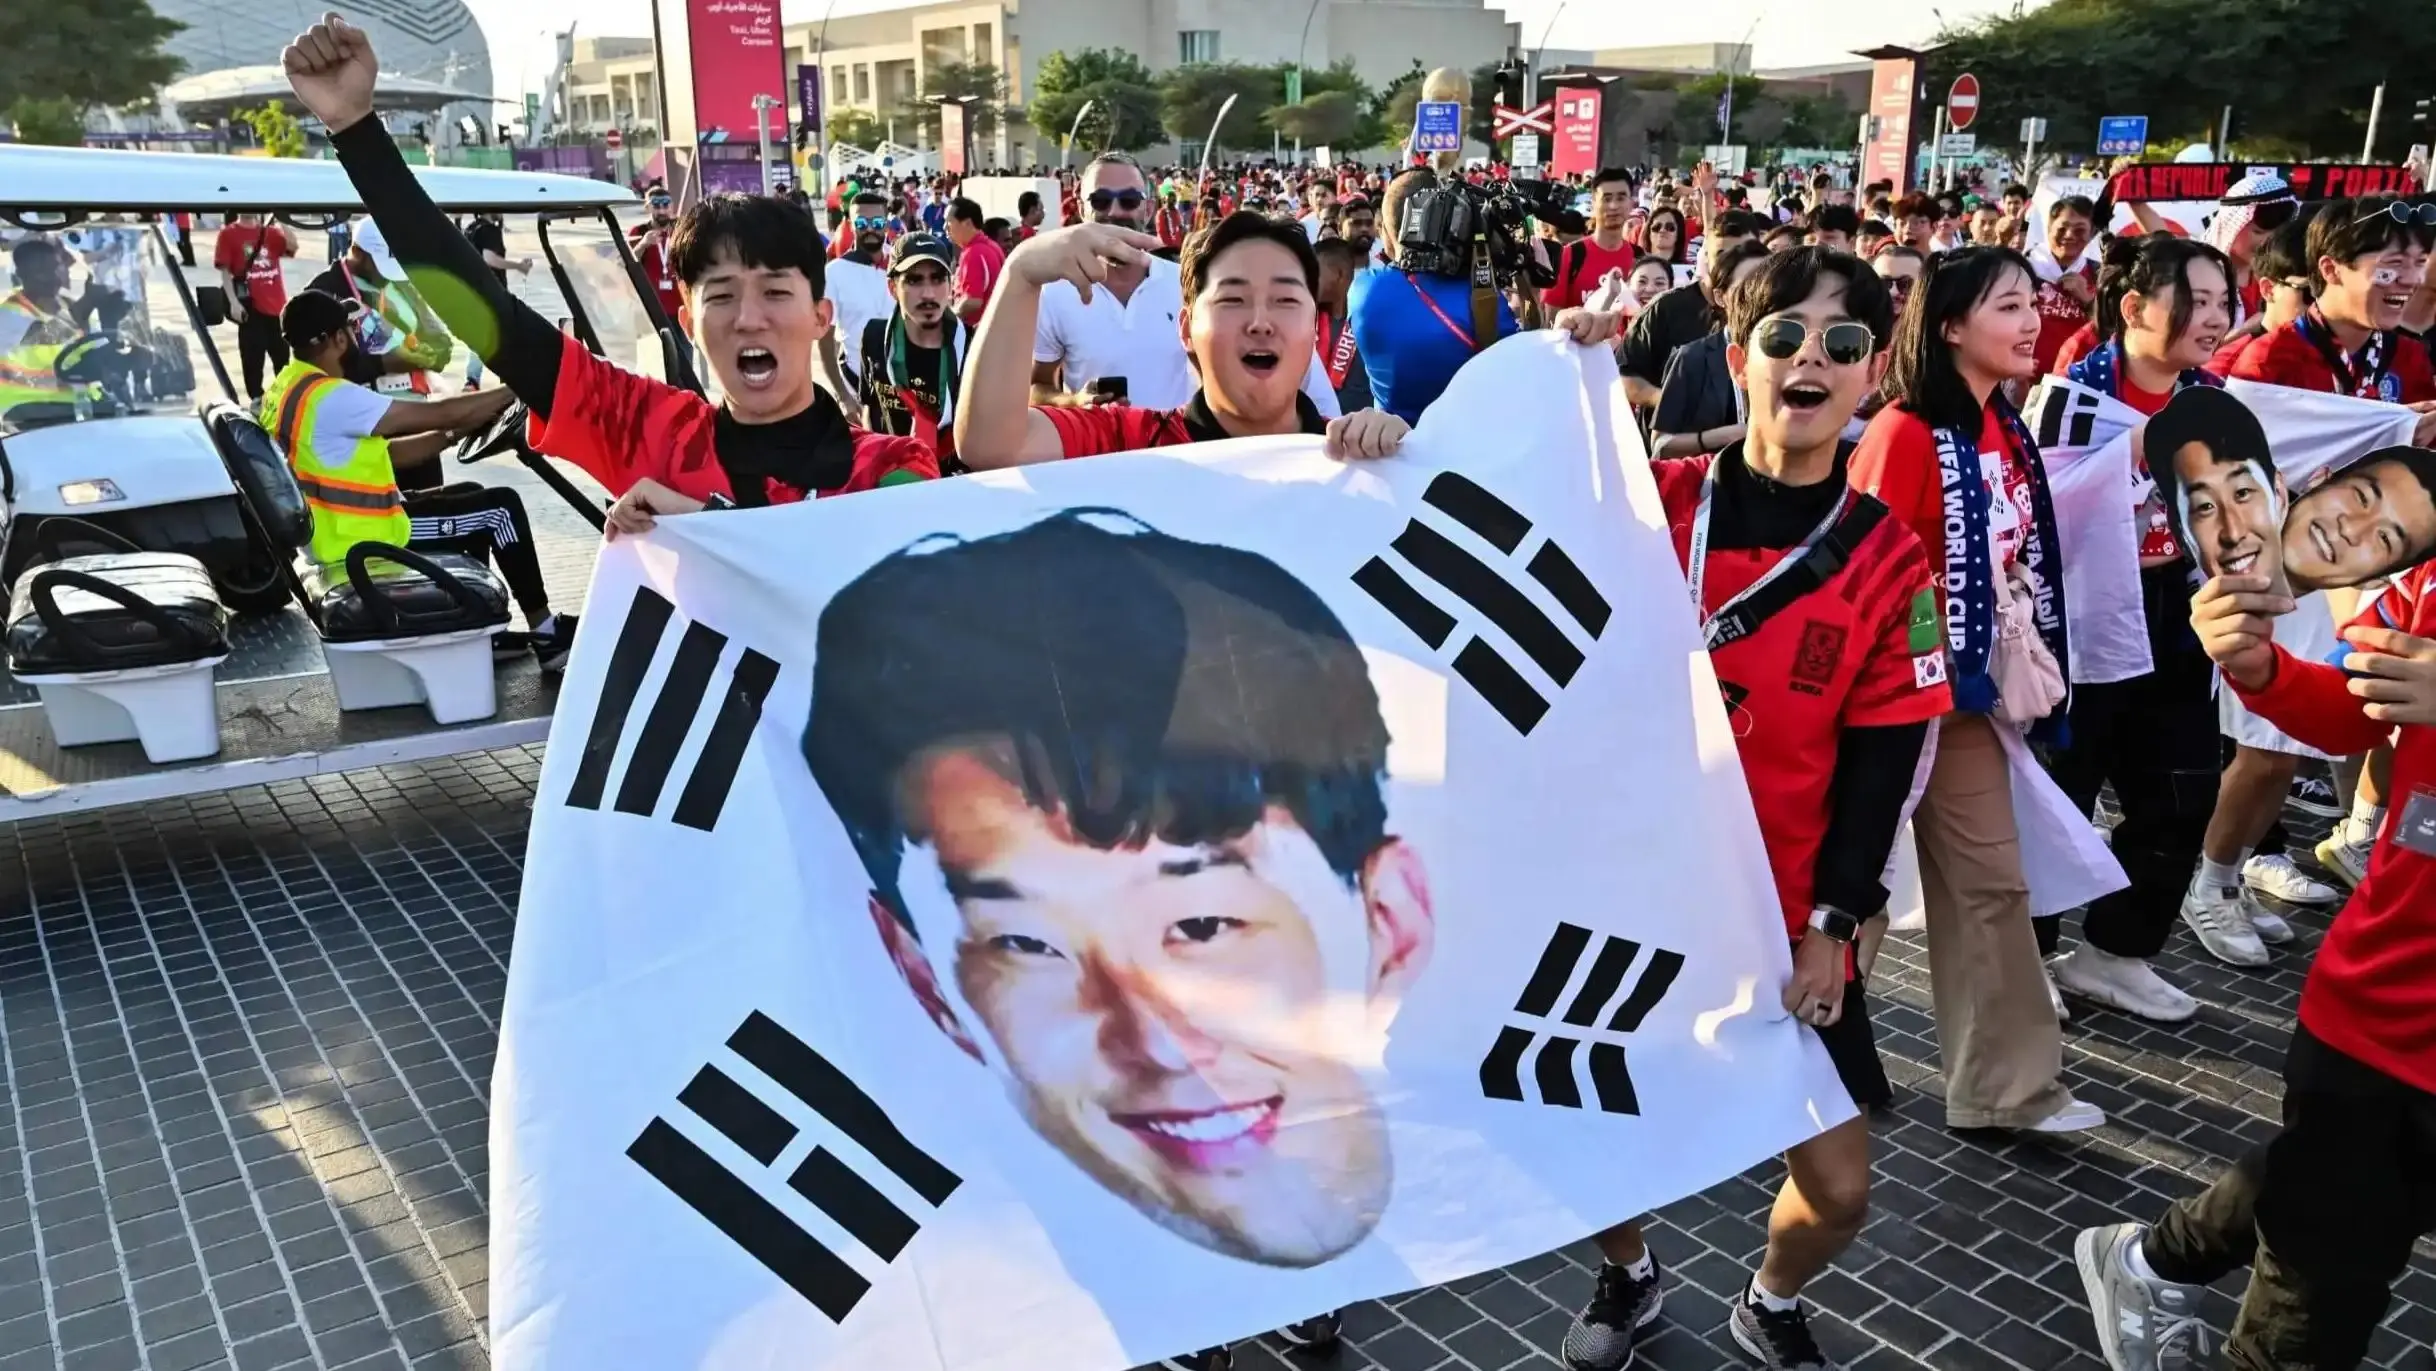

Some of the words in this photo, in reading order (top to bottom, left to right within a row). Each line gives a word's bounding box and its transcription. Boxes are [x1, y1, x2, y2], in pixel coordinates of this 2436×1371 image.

[1933, 428, 1961, 488] FIFA
[1944, 489, 1966, 592] WORLD
[1945, 597, 1966, 651] CUP
